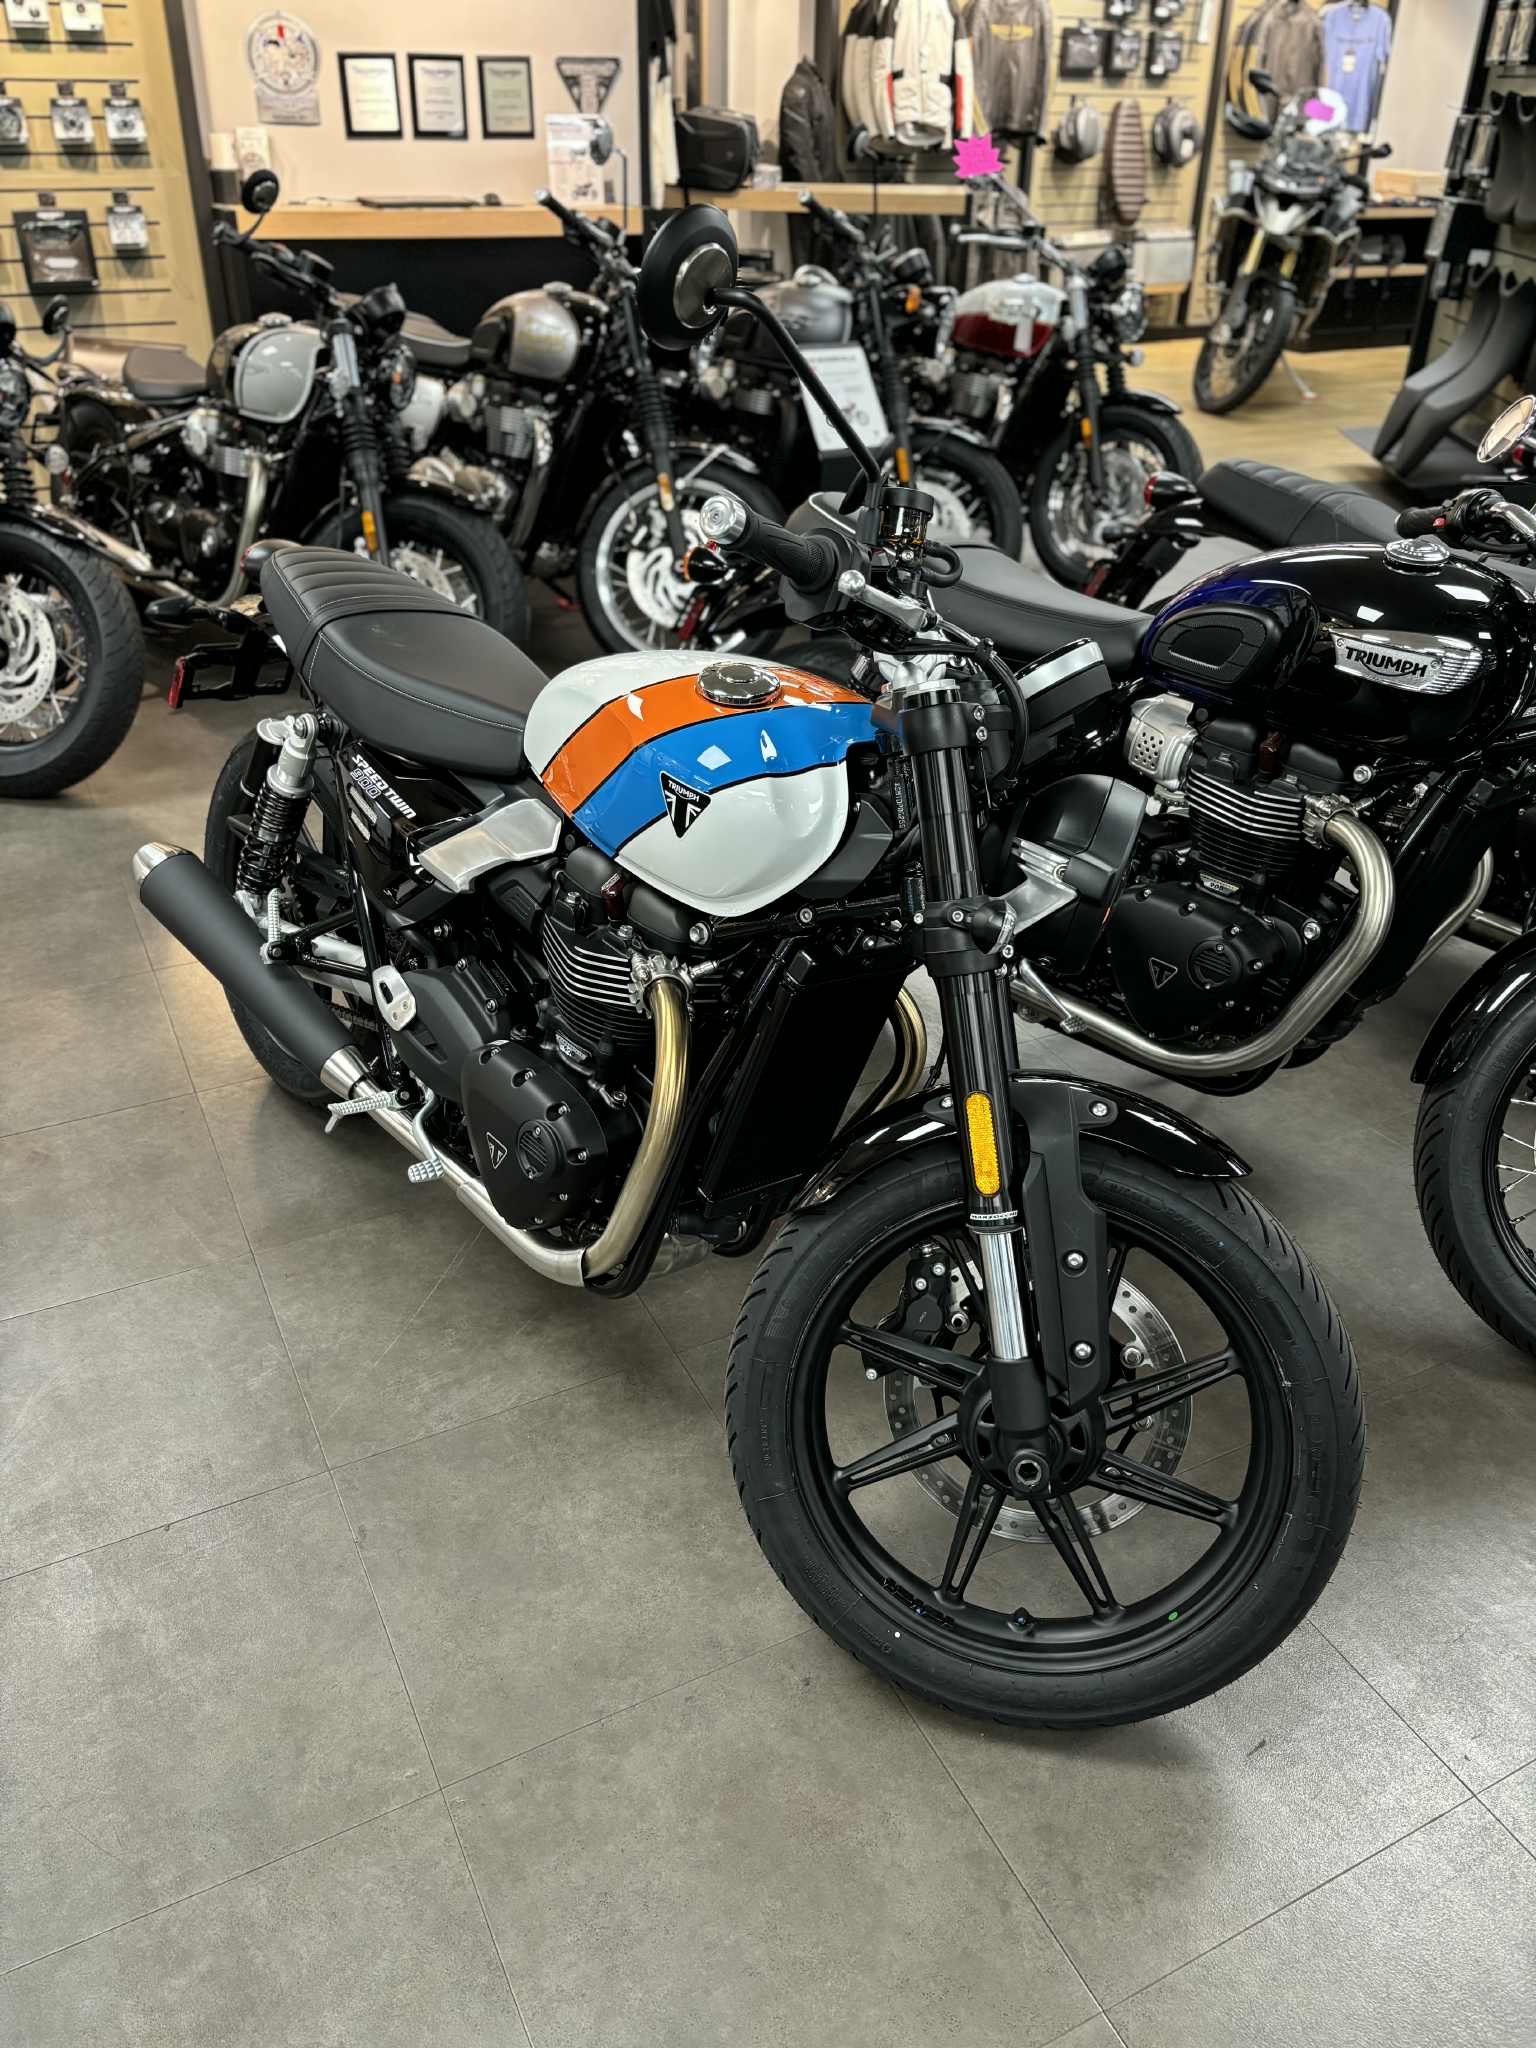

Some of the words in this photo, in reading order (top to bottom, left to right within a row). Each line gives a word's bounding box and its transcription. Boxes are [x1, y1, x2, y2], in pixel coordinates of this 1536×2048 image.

[1345, 646, 1428, 678] TRIUMPH
[350, 768, 382, 799] 900
[351, 754, 389, 791] SPEED
[383, 787, 417, 819] TWIN
[668, 779, 700, 803] TRIUMPH
